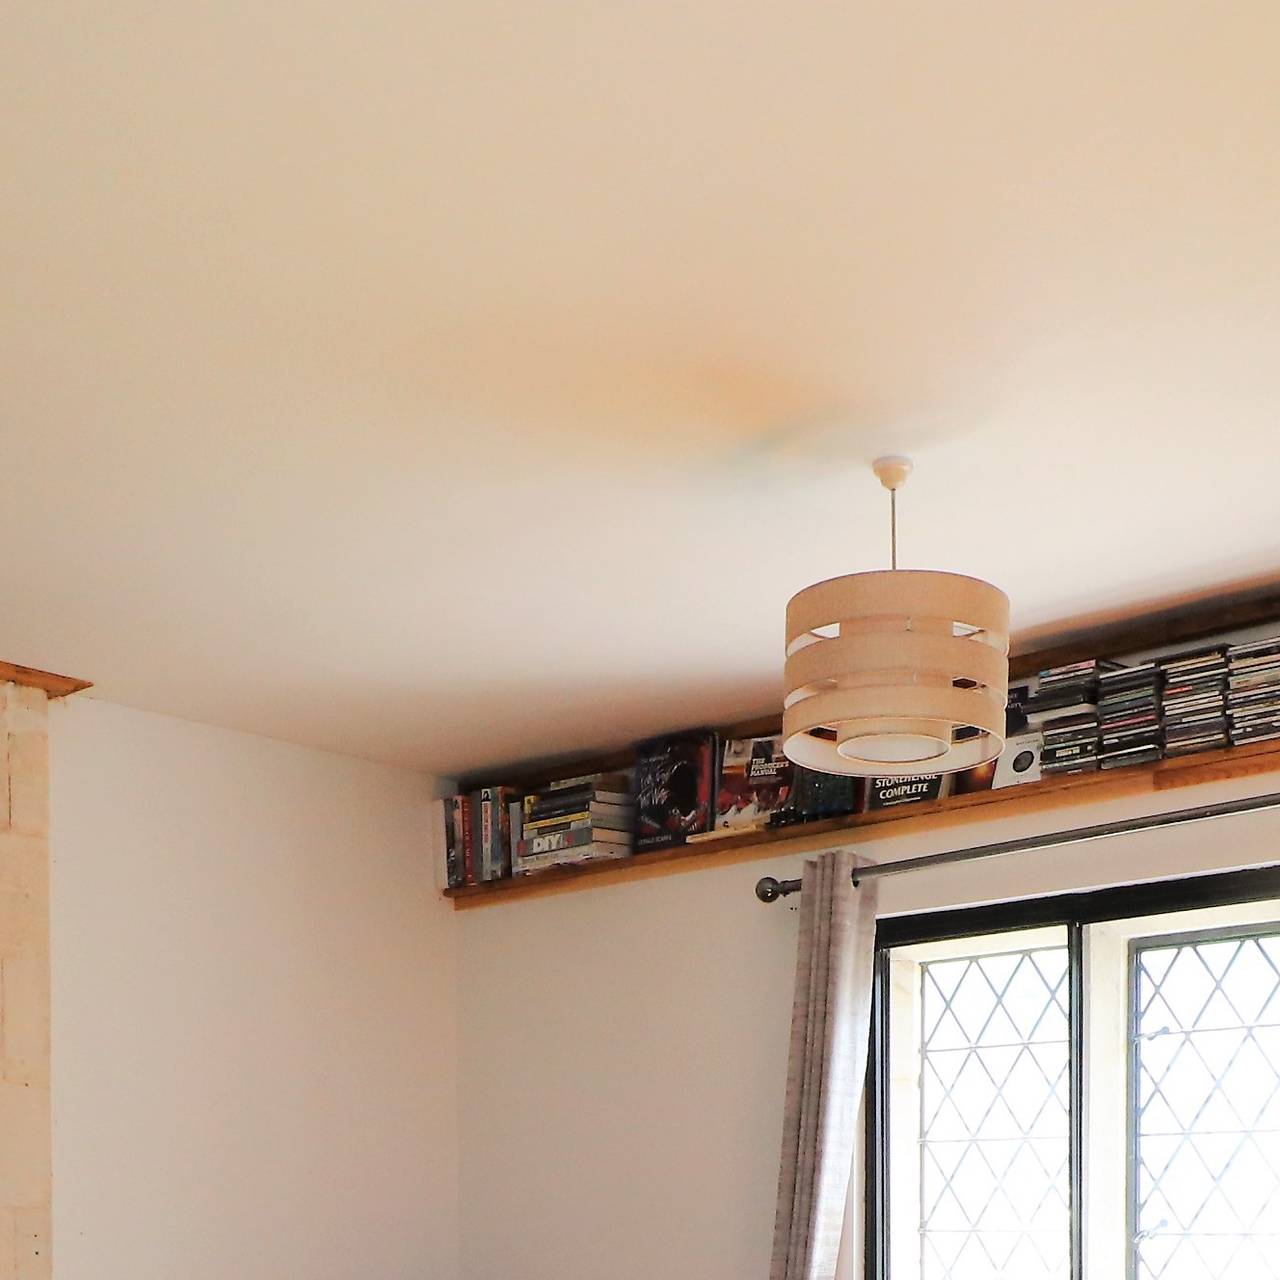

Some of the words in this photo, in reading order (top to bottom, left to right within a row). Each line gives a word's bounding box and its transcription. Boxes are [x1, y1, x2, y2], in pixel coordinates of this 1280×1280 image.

[750, 768, 777, 777] MANUAL
[879, 783, 929, 799] COMPLETE
[533, 834, 561, 853] DIY
